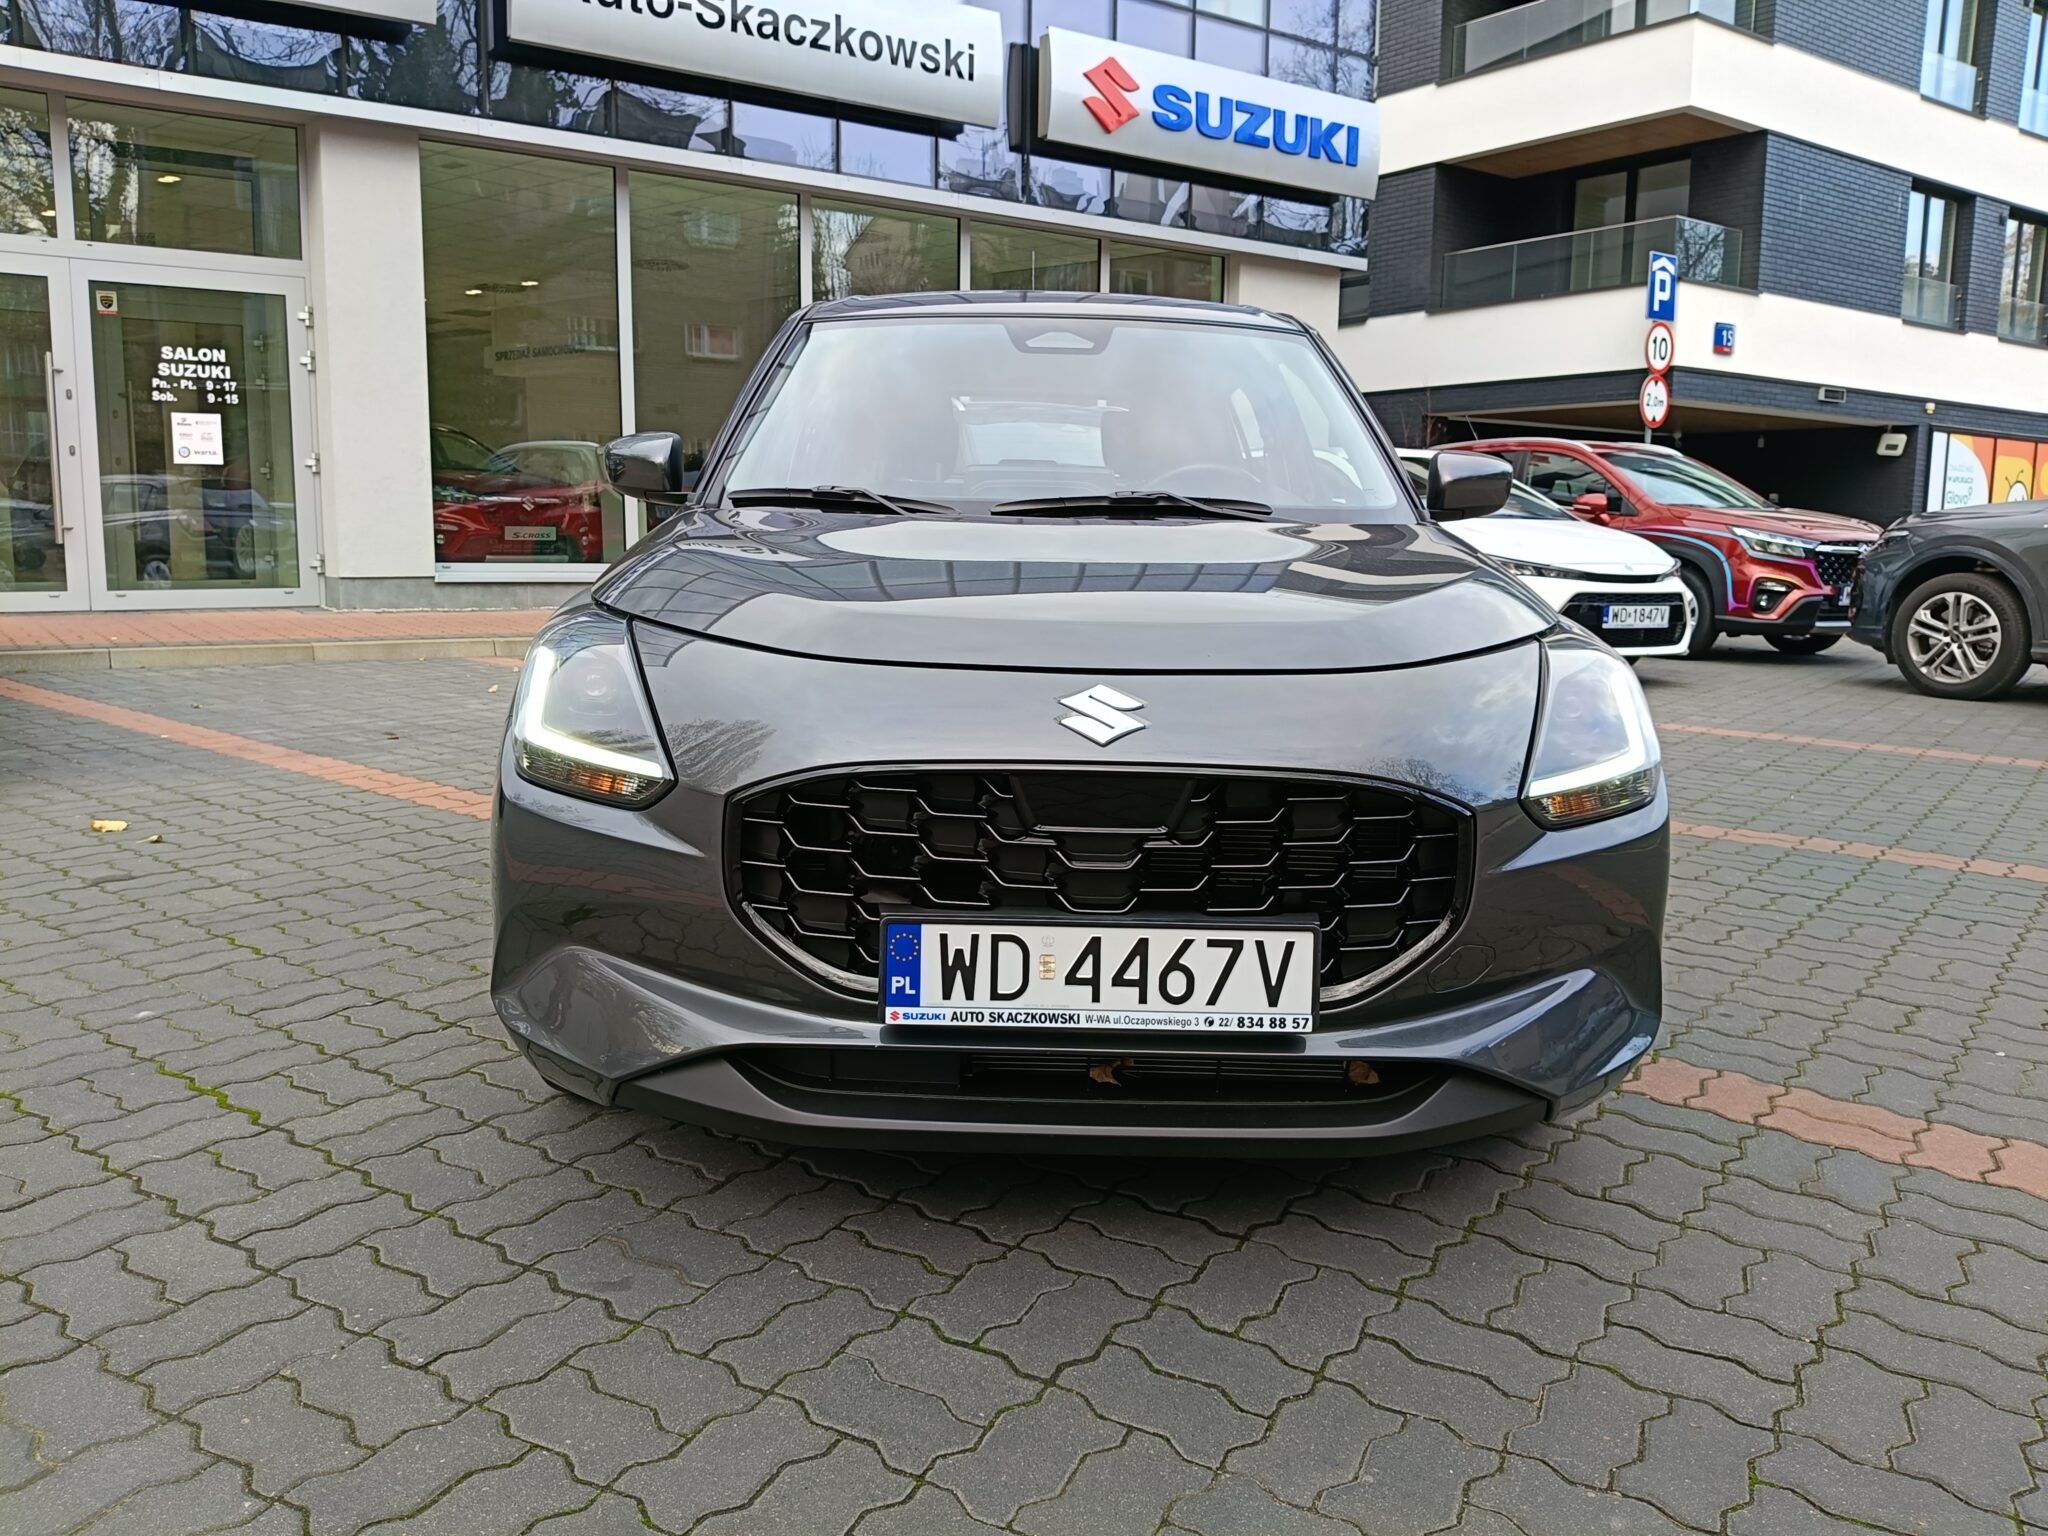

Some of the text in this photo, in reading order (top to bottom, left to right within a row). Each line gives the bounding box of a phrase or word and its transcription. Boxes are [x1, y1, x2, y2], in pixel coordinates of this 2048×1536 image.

[581, 0, 975, 82] o-Skaczkowski
[1152, 84, 1359, 167] SUZUKI
[1653, 271, 1671, 311] P
[1722, 329, 1733, 346] 15
[161, 346, 226, 362] SALON
[1652, 336, 1668, 361] 10
[157, 363, 231, 379] SUZUKI
[152, 378, 171, 389] Pn.
[180, 380, 197, 390] Pt.
[206, 381, 214, 391] 9
[223, 382, 237, 391] 17
[152, 391, 178, 402] Sob.
[207, 394, 215, 404] 9
[224, 394, 239, 405] 15
[1946, 490, 1969, 505] Glovo
[1611, 607, 1628, 623] WD
[1633, 607, 1667, 623] 1847V
[939, 932, 1296, 1008] WD 4467V
[891, 976, 916, 994] PL
[902, 1011, 1310, 1030] SUZUKI AUTO SKACZKOWSKI W-WA ul.Oczapowskiego 3 22/ 834 88 57
